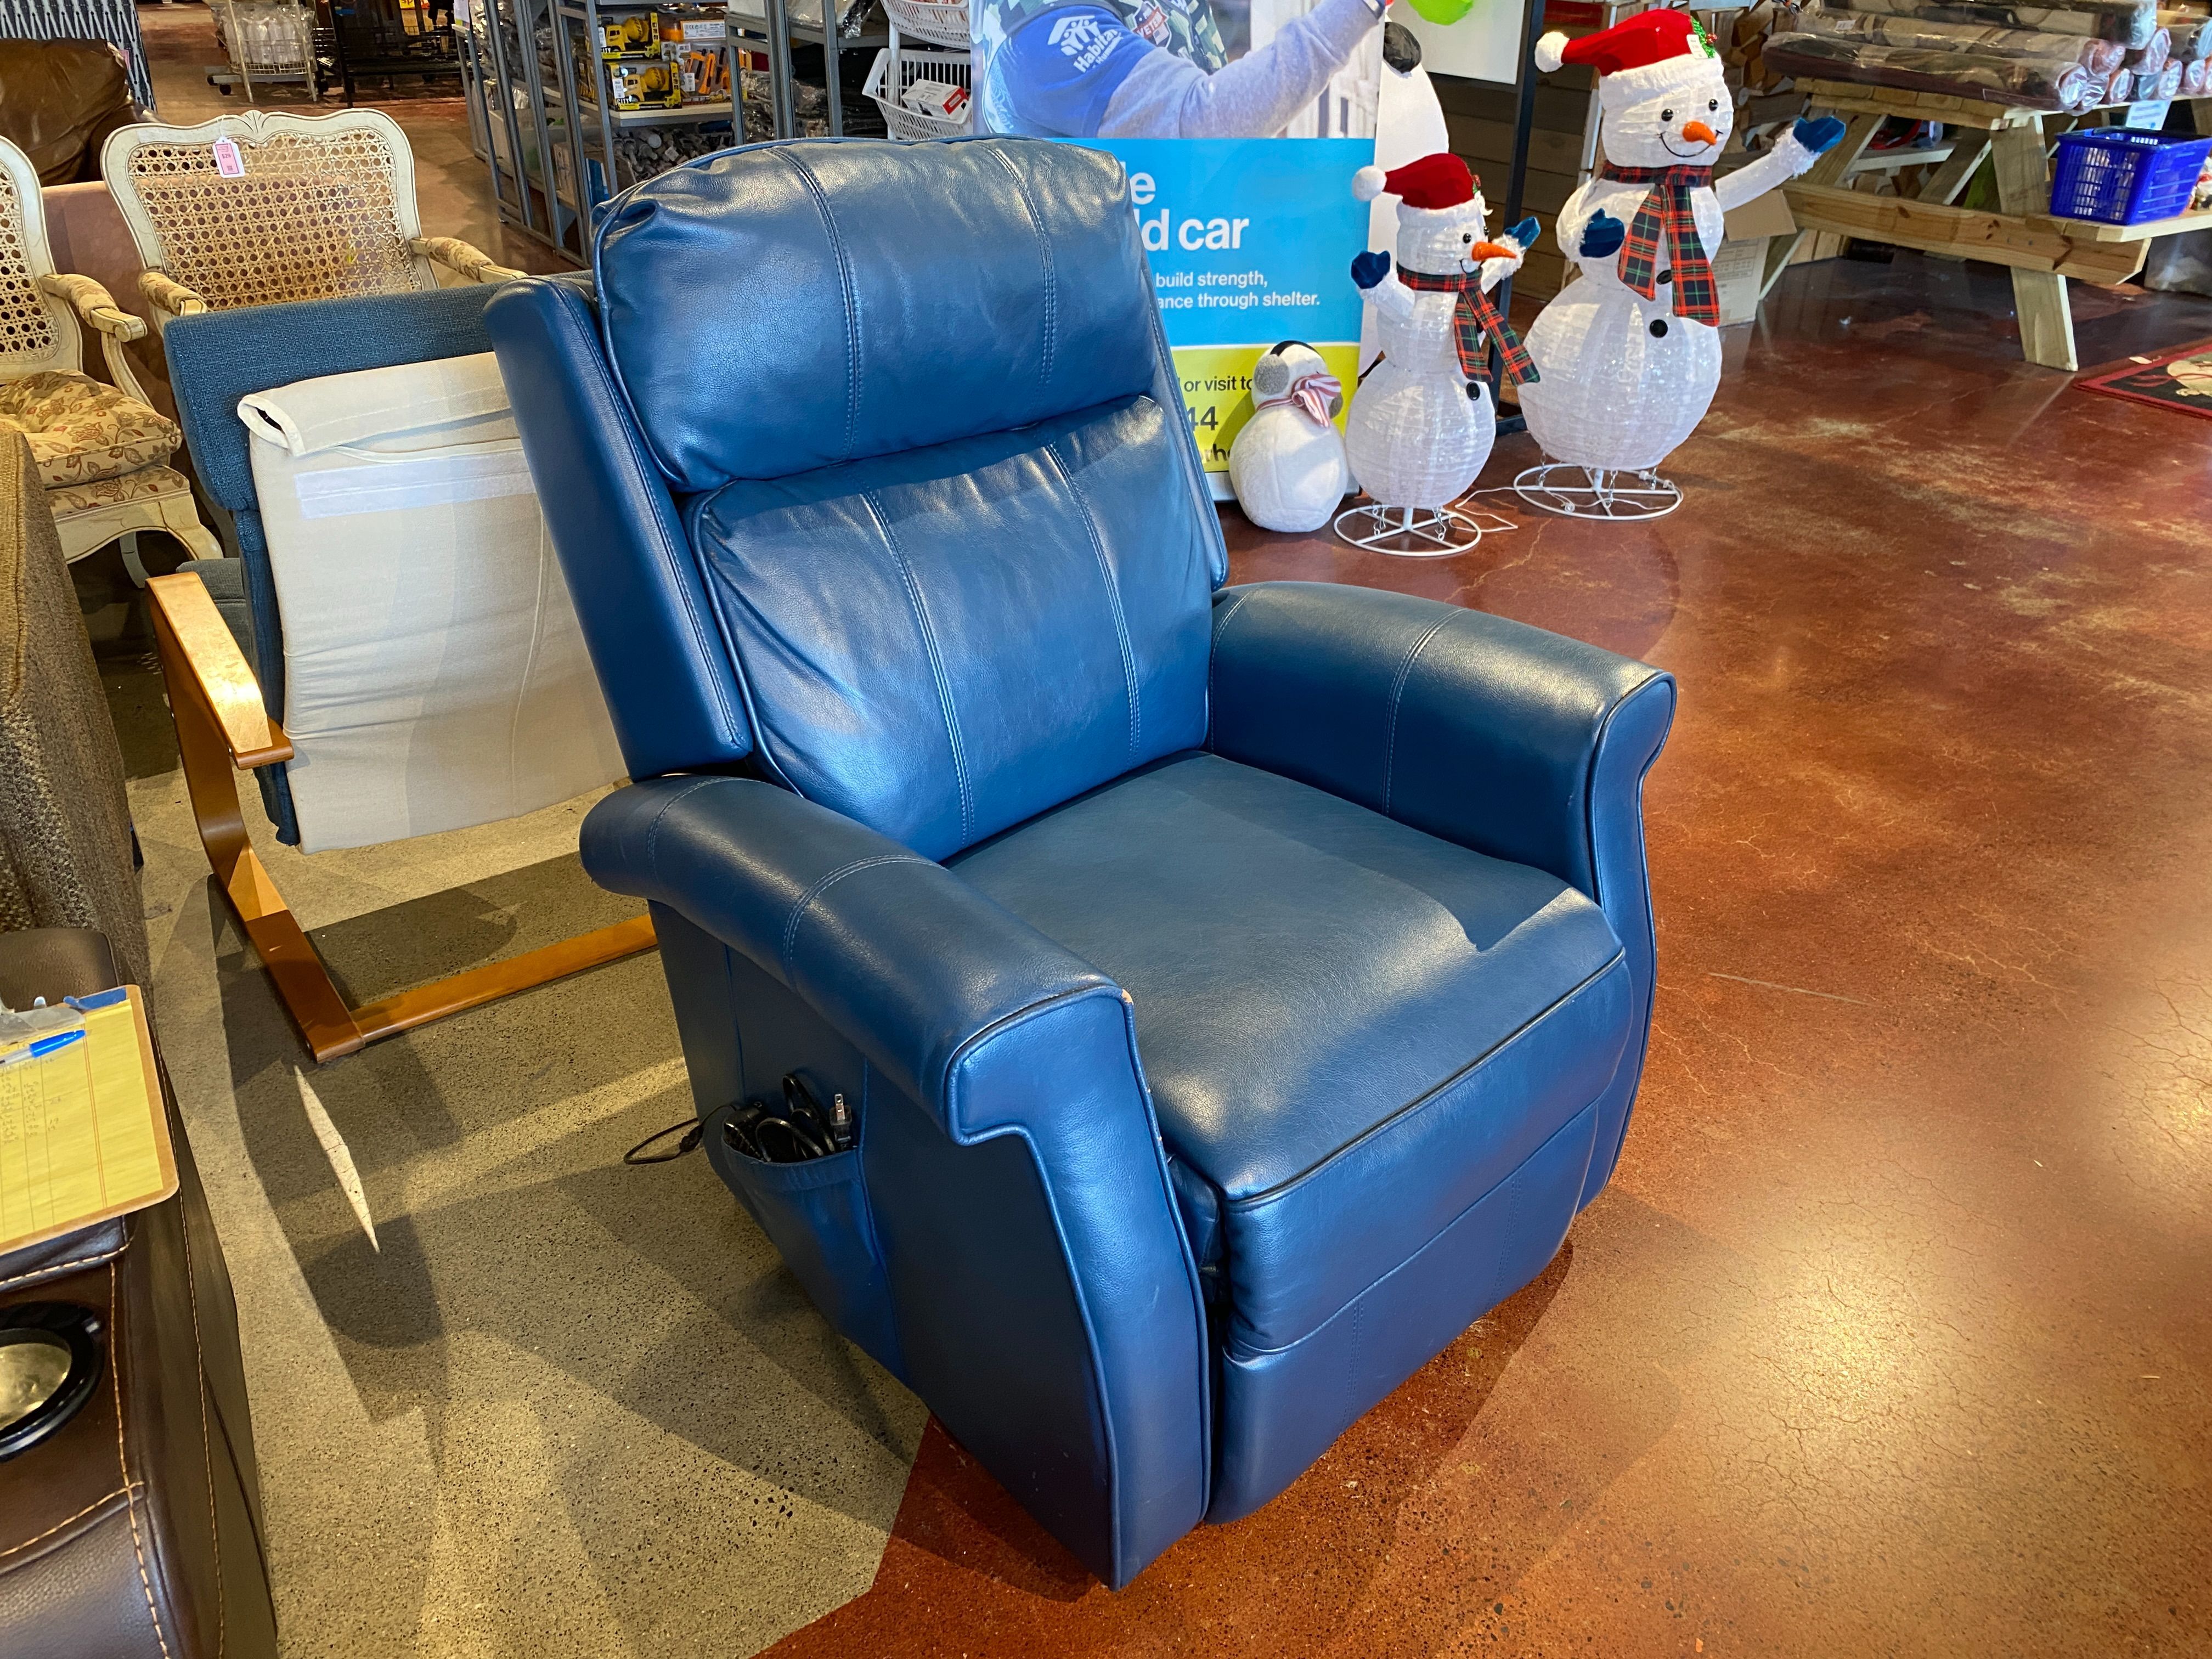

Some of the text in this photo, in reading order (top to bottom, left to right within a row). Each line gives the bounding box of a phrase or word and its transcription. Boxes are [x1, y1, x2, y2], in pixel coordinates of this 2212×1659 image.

[1178, 218, 1250, 251] car
[1155, 270, 1268, 289] build strength,
[1198, 291, 1259, 310] through
[1263, 291, 1321, 307] shelter.
[1184, 380, 1201, 392] or
[1204, 375, 1237, 392] visit
